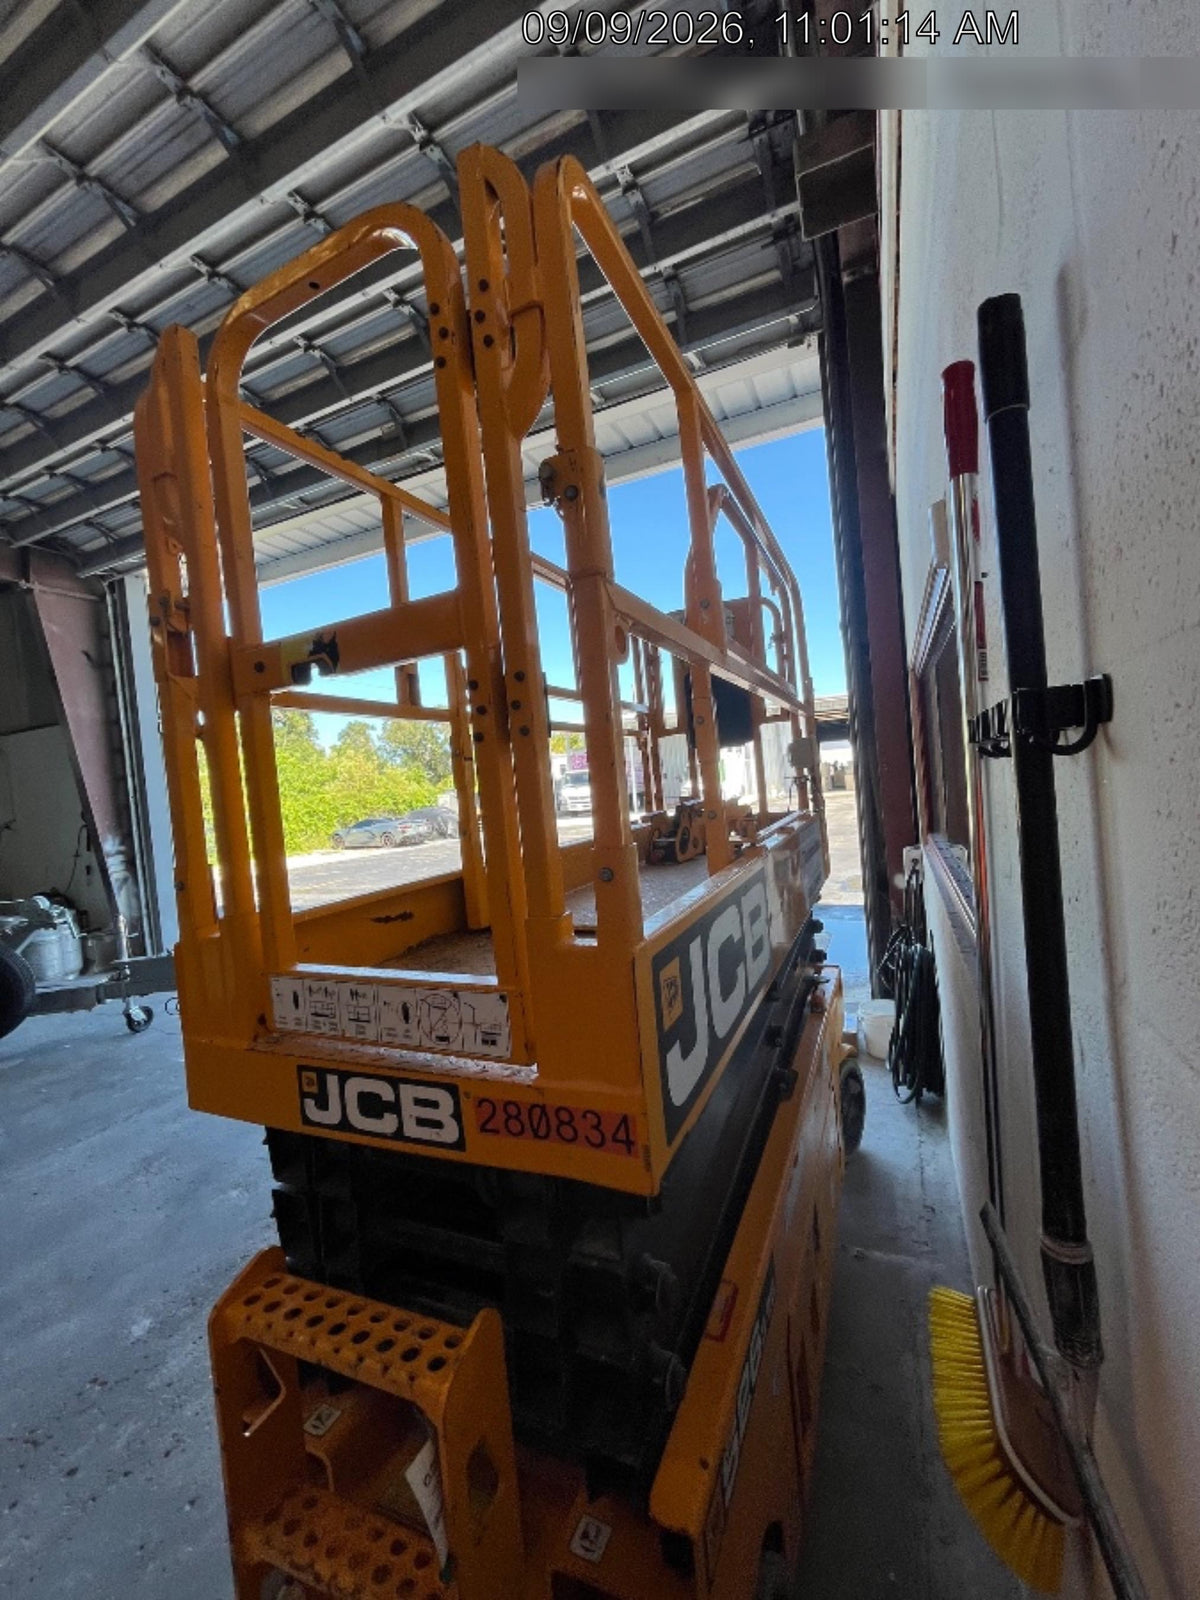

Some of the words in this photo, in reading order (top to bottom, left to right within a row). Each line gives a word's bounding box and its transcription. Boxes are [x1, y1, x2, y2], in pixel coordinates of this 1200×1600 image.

[665, 882, 771, 1107] JCB
[303, 1073, 460, 1144] JCB
[476, 1098, 636, 1156] 280834
